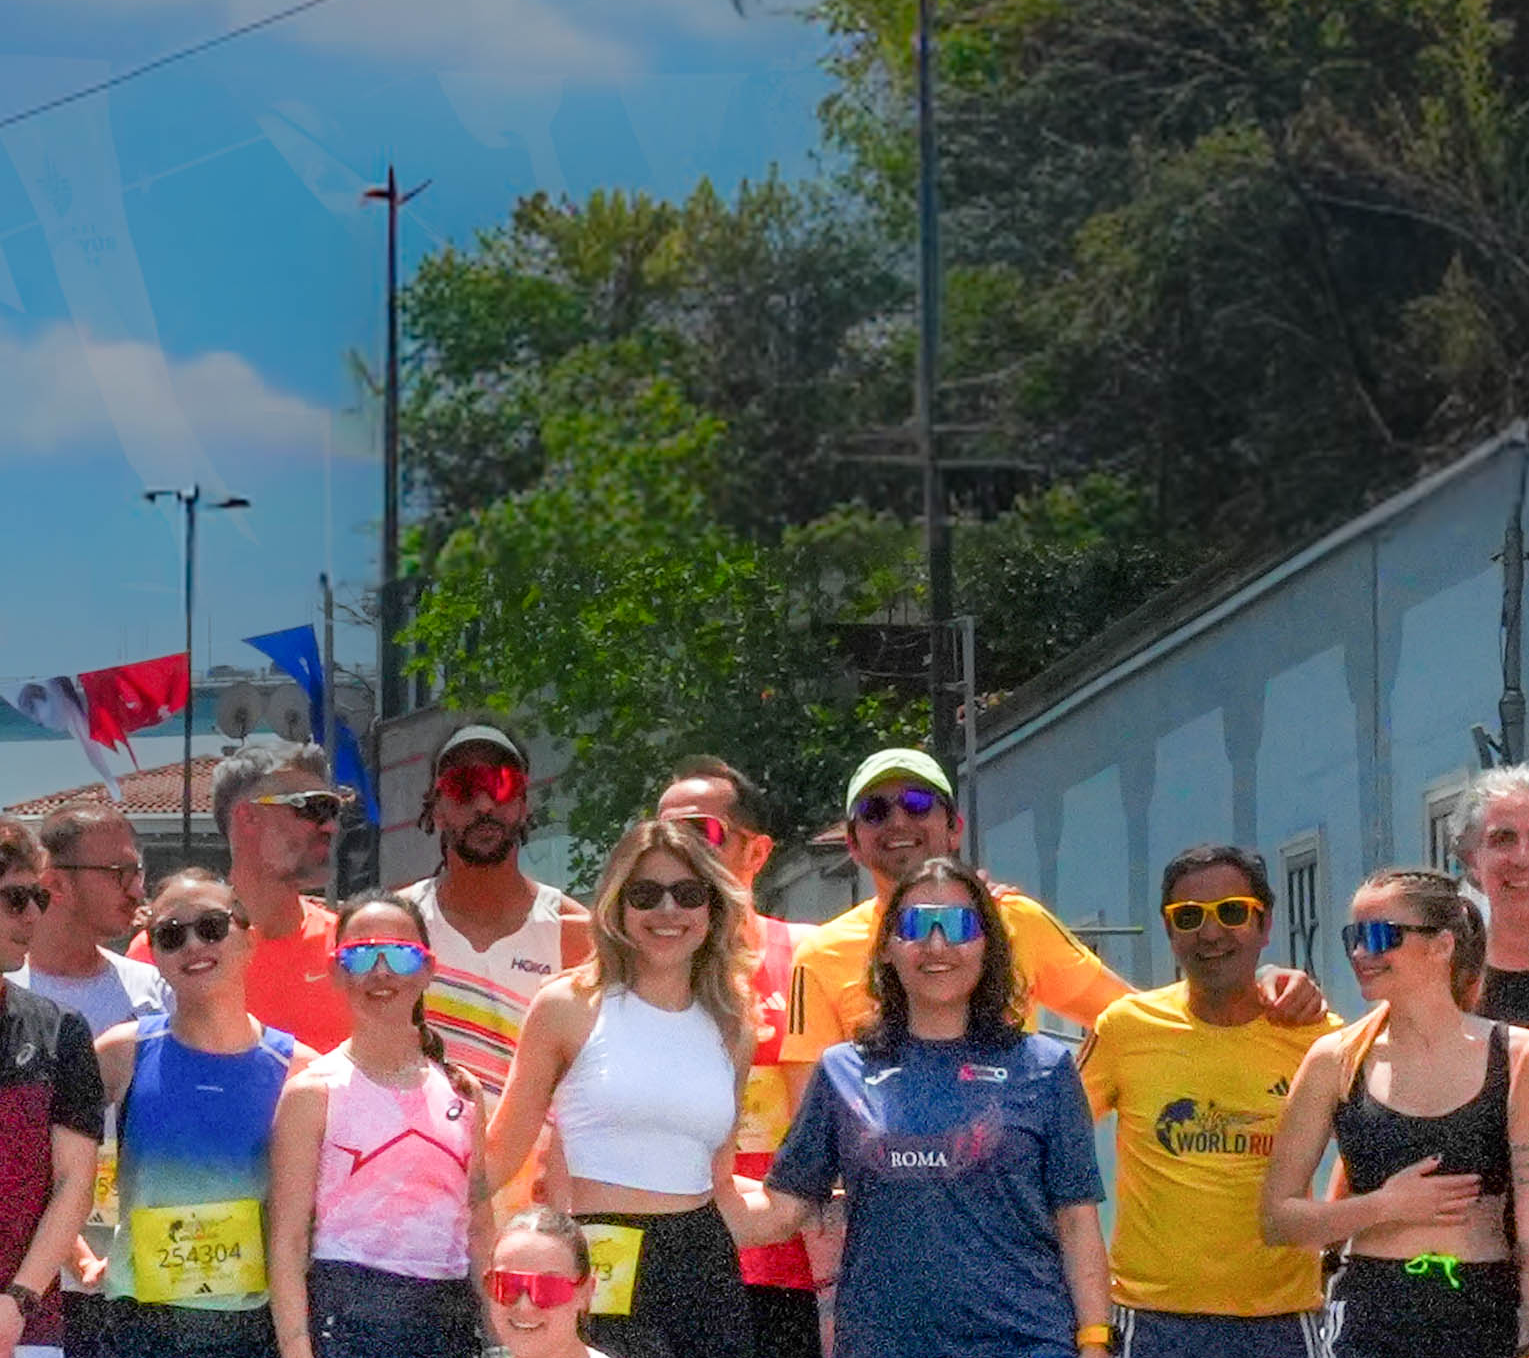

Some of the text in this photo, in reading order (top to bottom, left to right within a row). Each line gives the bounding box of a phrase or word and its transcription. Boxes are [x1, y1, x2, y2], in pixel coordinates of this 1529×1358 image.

[1177, 1132, 1274, 1156] WORLD RU
[890, 1151, 949, 1167] ROMA
